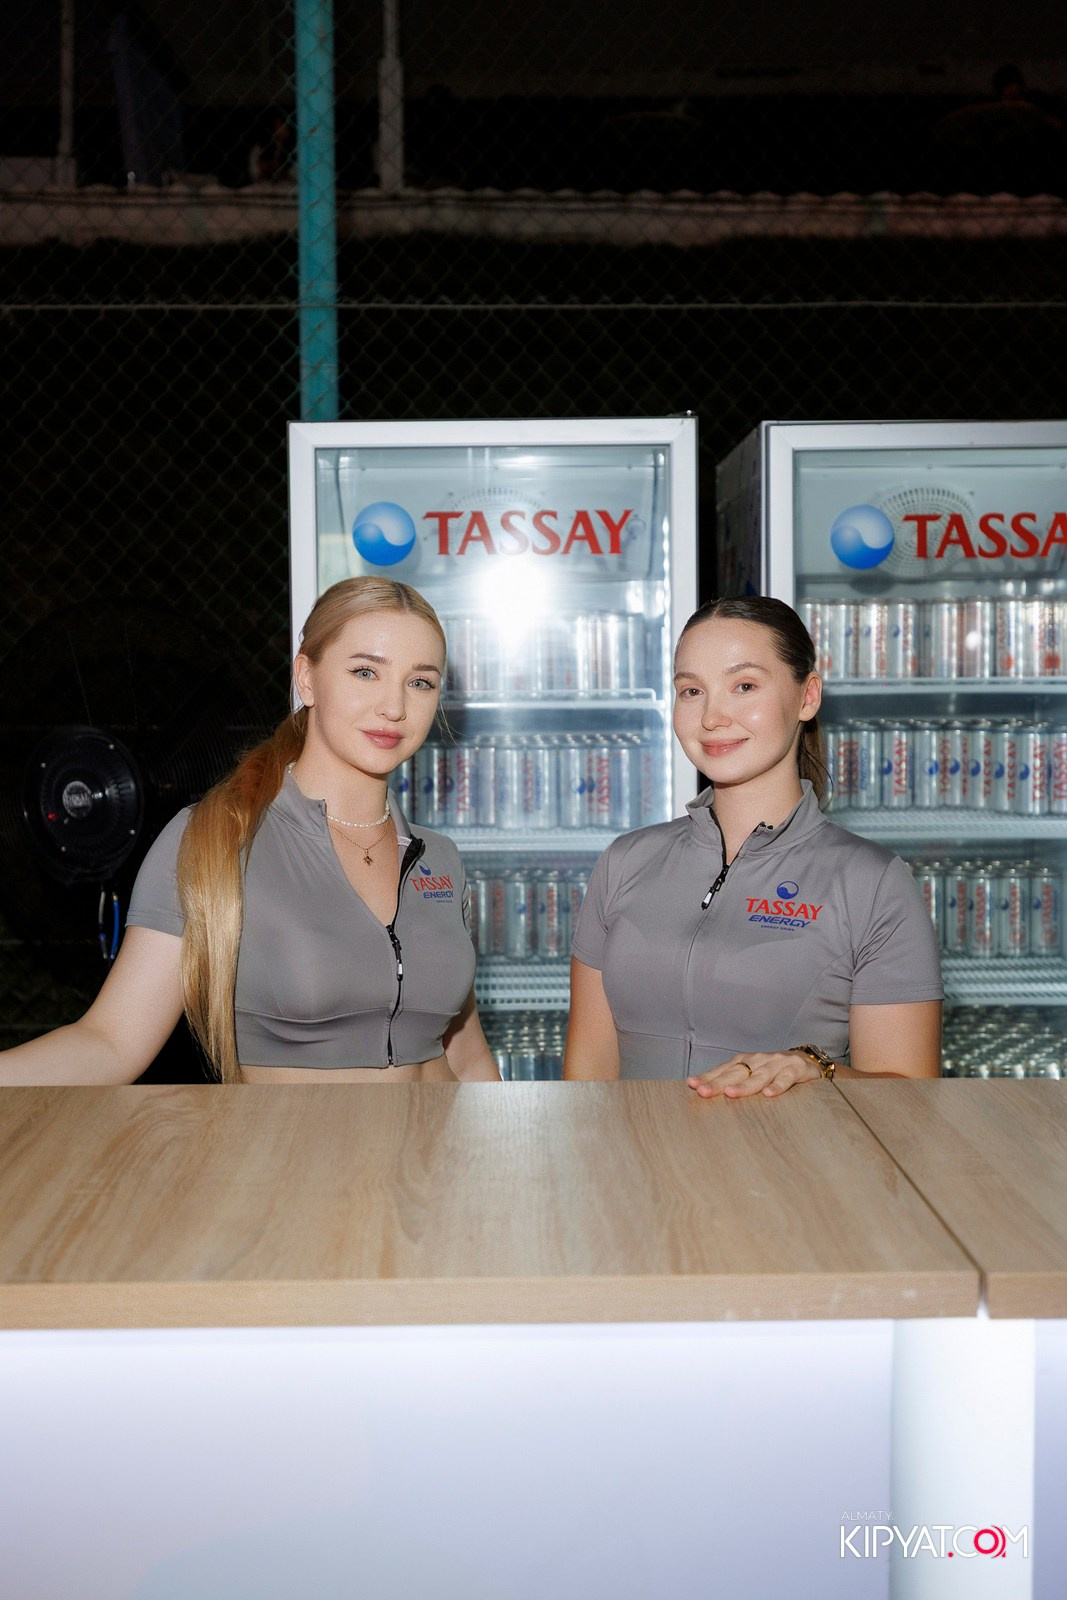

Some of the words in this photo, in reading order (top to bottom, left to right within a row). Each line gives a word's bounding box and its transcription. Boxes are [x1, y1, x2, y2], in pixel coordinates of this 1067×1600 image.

[422, 509, 634, 556] TASSAY
[409, 875, 454, 892] TASSAY
[745, 898, 823, 920] TASSAY
[748, 915, 811, 928] ENERGY
